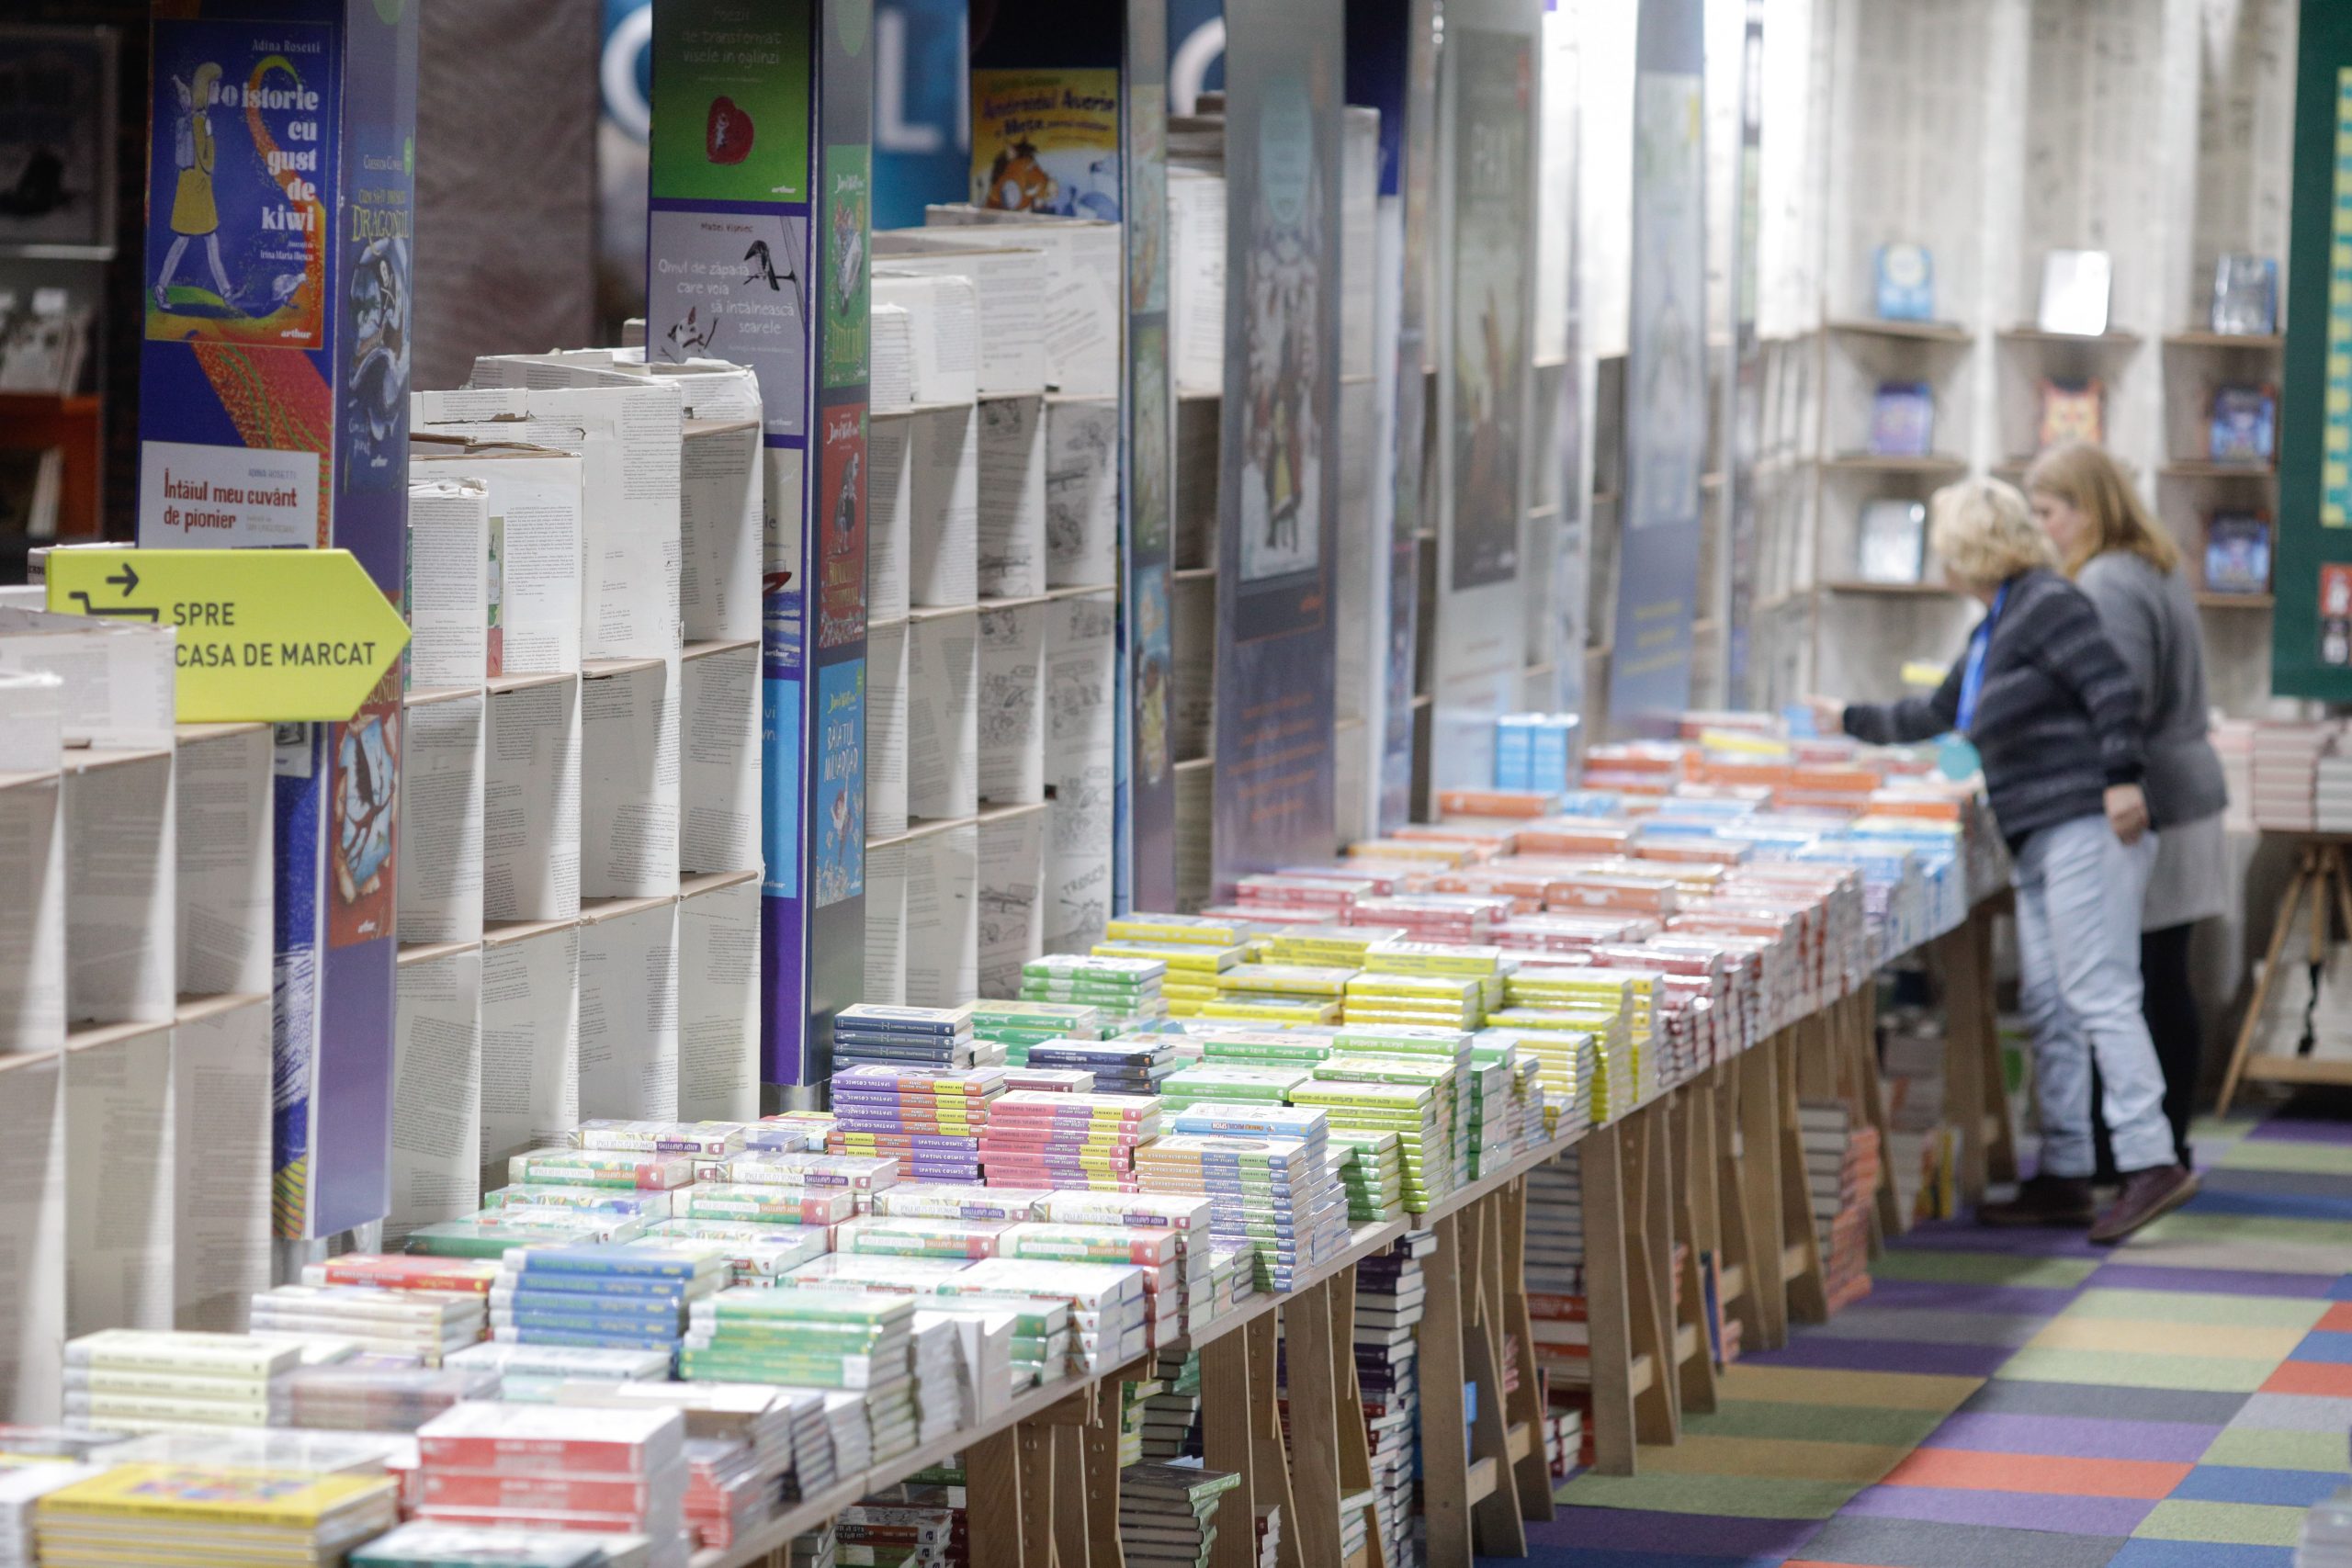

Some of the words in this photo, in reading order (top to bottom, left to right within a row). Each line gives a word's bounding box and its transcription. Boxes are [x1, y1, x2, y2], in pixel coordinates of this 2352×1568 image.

[252, 39, 281, 51] Adina
[283, 39, 321, 53] Rosetti
[242, 82, 320, 110] istorie
[288, 120, 317, 141] cu
[266, 148, 317, 175] gust
[287, 177, 316, 201] de
[261, 204, 314, 231] kiwi
[658, 258, 688, 274] Omul
[690, 261, 707, 275] de
[676, 281, 704, 295] care
[707, 280, 729, 295] voia
[710, 301, 723, 313] să
[280, 327, 312, 339] arthur
[738, 321, 782, 334] soarele
[212, 486, 243, 504] meu
[246, 487, 298, 507] cuvânt
[164, 505, 180, 525] de
[184, 508, 236, 534] pionier
[173, 603, 236, 626] SPRE
[174, 643, 236, 668] CASA
[243, 643, 273, 666] DE
[280, 642, 376, 667] MARCAT
[763, 649, 790, 659] arthur
[1212, 1122, 1227, 1130] SPION
[658, 1142, 684, 1150] GRIFFITHS
[961, 1208, 988, 1216] GRIFFITHS
[1124, 1214, 1150, 1224] GRIFFITHS
[1151, 1216, 1165, 1224] ANDY
[953, 1241, 967, 1249] ANDY
